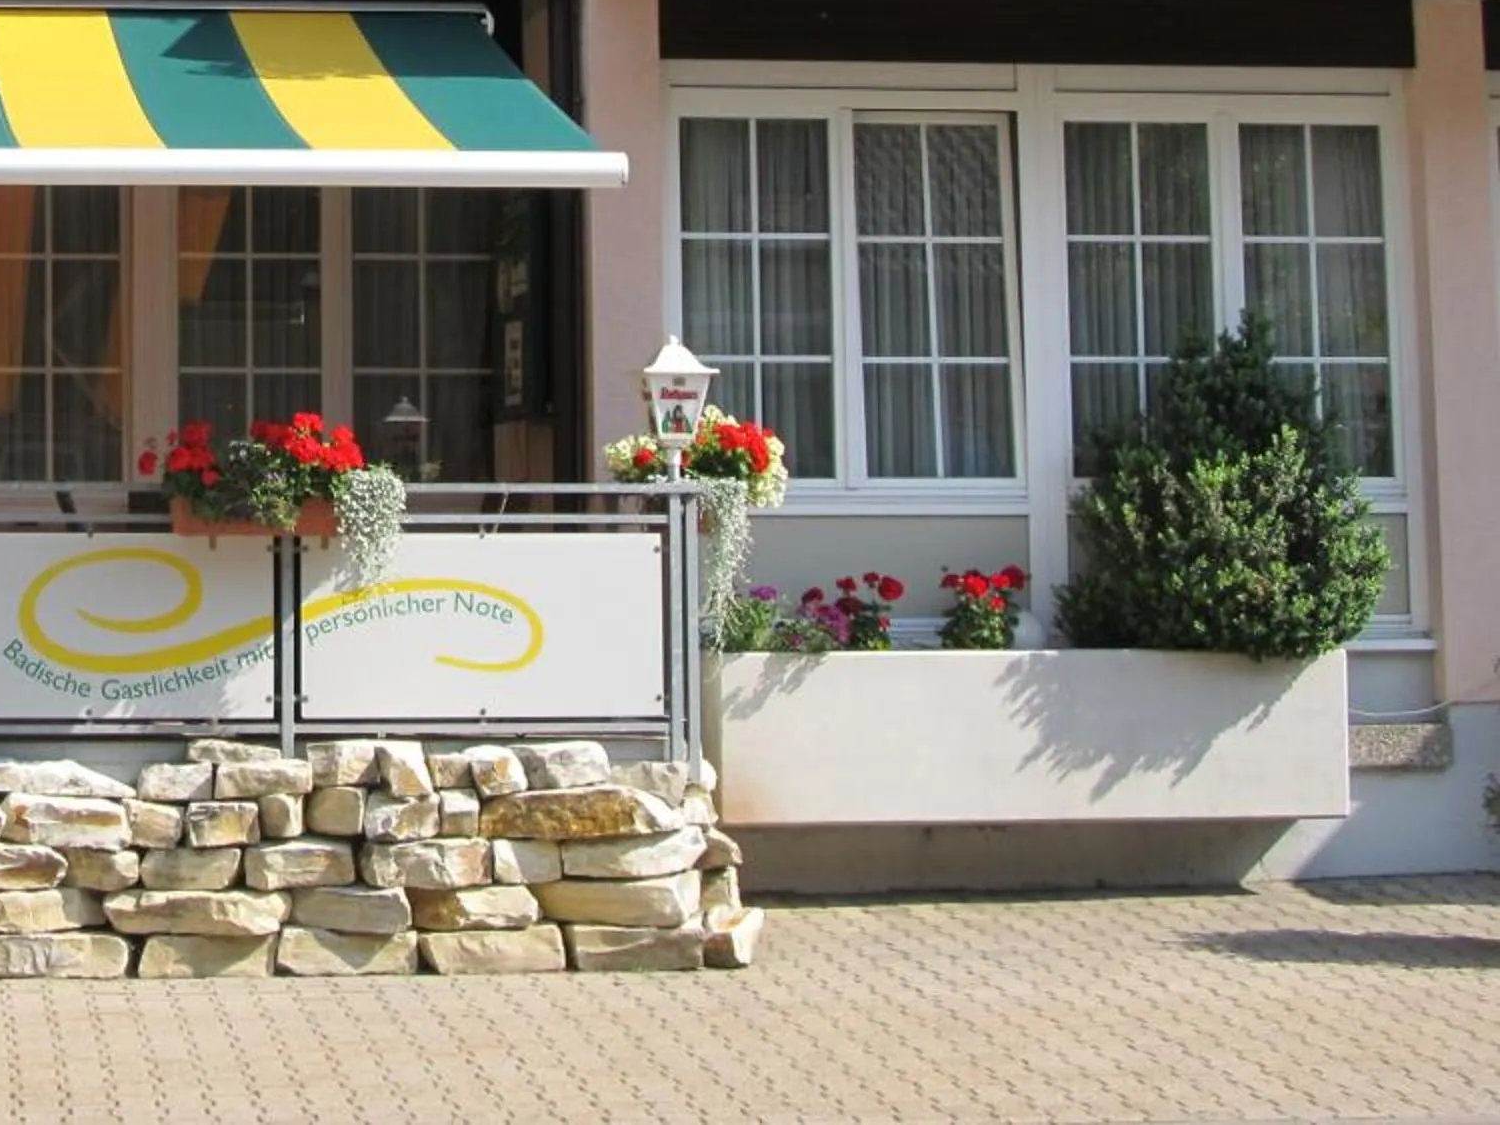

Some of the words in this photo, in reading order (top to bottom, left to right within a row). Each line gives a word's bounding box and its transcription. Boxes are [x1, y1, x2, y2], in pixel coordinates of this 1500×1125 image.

[3, 638, 92, 698] Badische
[101, 656, 230, 701] Gastlichkeit
[304, 592, 446, 647] persönlicher
[453, 591, 514, 625] Note
